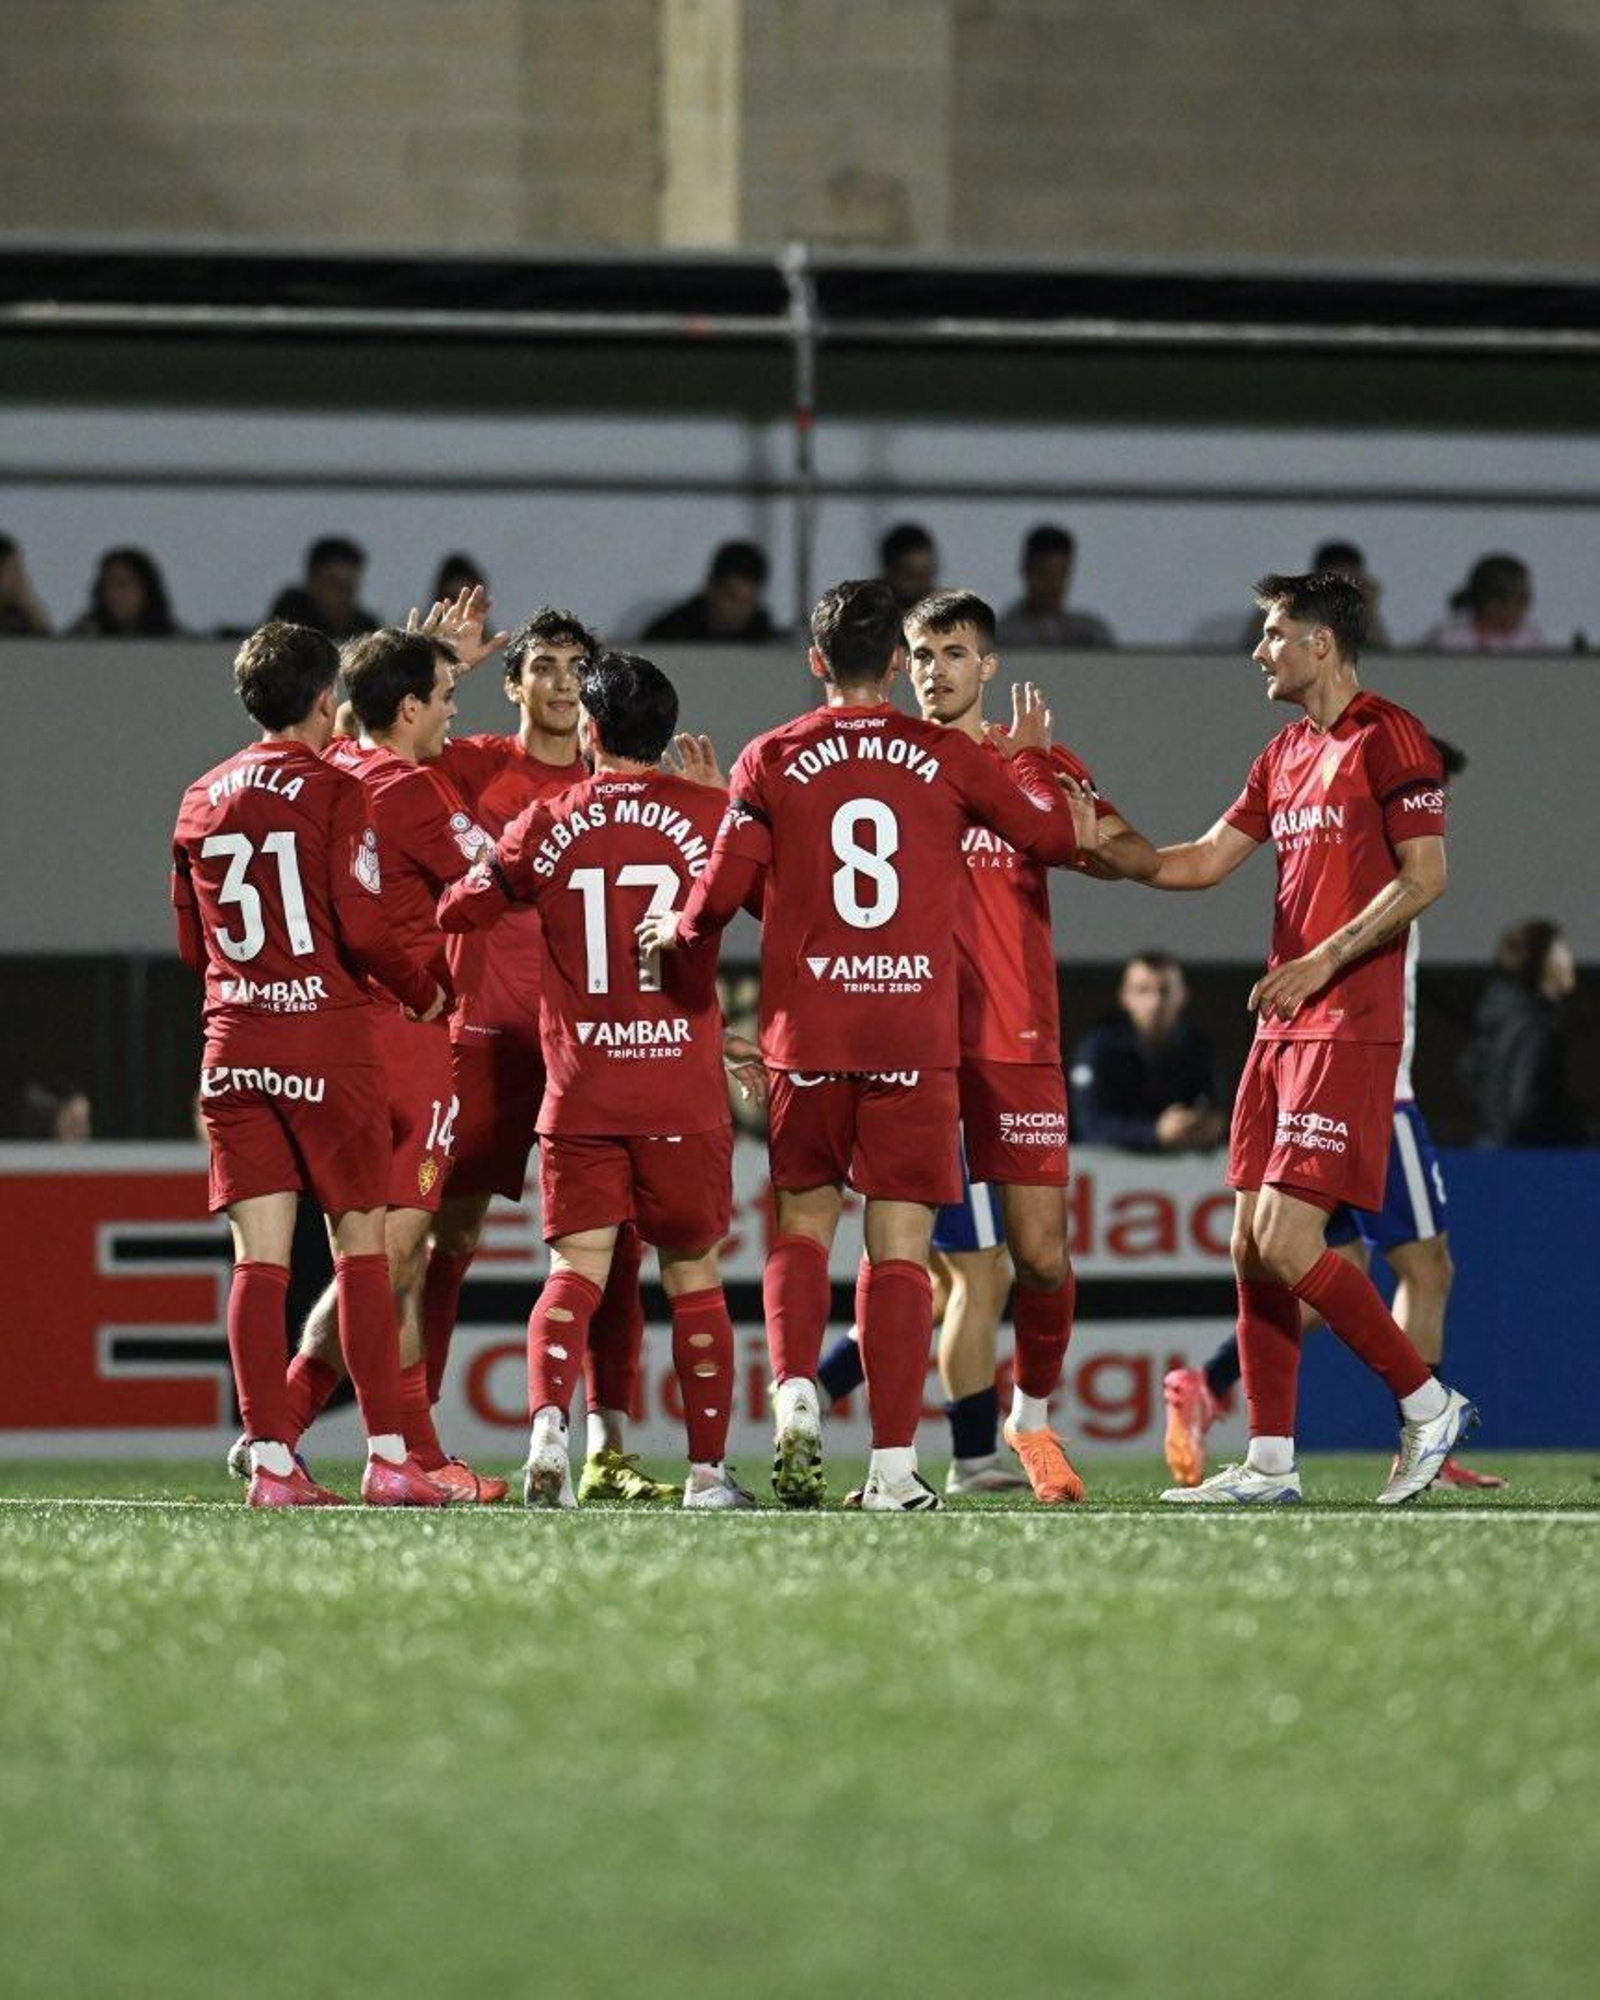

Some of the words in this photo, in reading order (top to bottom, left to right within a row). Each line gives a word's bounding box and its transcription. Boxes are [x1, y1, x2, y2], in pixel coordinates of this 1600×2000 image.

[783, 735, 849, 784] TONI
[857, 736, 940, 784] MOYA
[208, 764, 305, 807] PINILLA
[533, 802, 606, 877] SEBAS
[614, 799, 709, 878] MOYANO
[831, 797, 899, 929] 8
[200, 831, 315, 962] 31
[567, 864, 681, 994] 17
[829, 954, 933, 980] AMBAR
[843, 983, 884, 993] TRIPLE
[889, 983, 922, 993] ZERO
[236, 975, 329, 1004] AMBAR
[593, 1018, 693, 1046] AMBAR
[607, 1049, 646, 1059] TRIPLE
[650, 1048, 682, 1058] ZERO
[201, 1067, 325, 1103] embou
[425, 1094, 460, 1156] 14
